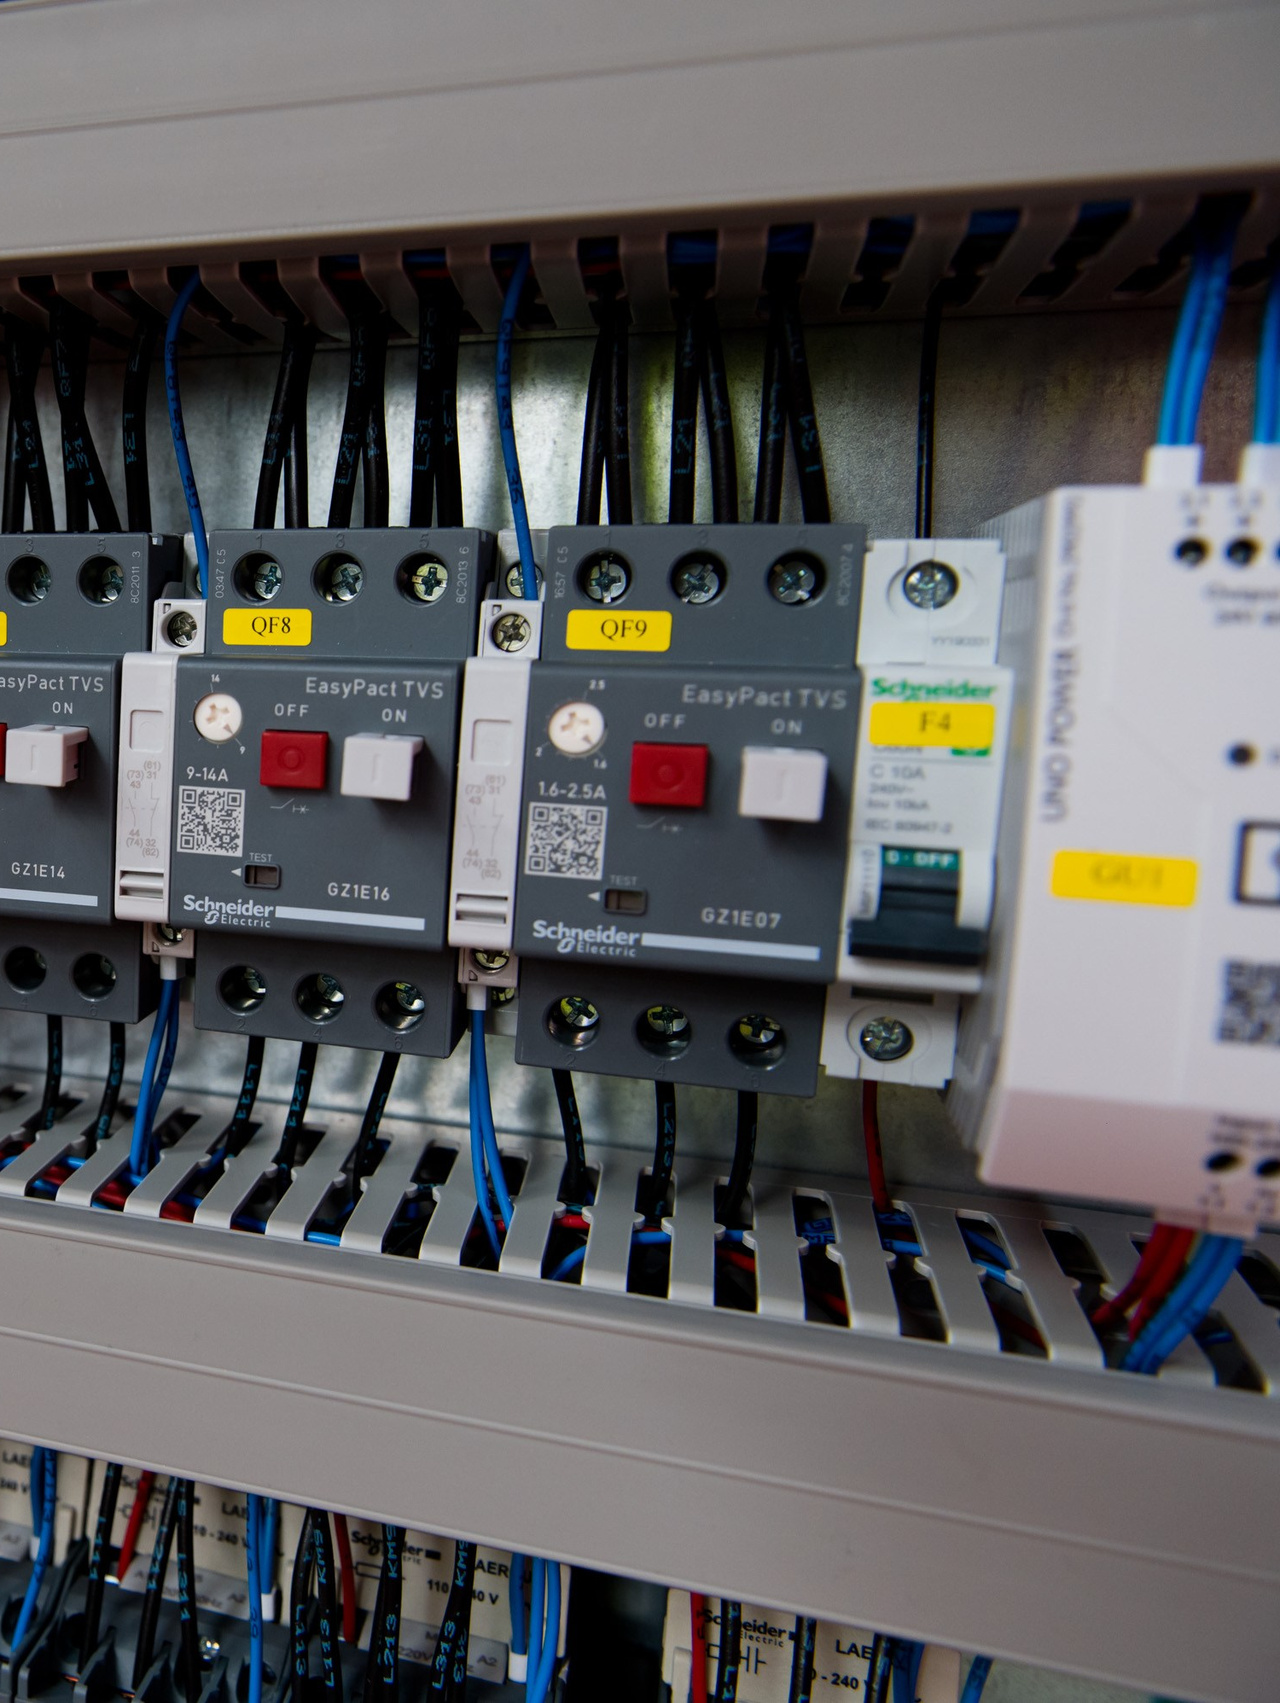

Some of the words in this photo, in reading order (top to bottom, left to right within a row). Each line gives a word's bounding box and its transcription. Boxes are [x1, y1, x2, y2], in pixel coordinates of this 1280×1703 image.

[251, 617, 291, 637] QF8
[599, 619, 647, 641] QF9
[69, 677, 104, 692] TVS
[306, 677, 397, 699] EasyPact
[403, 681, 444, 699] TVS
[871, 677, 998, 701] Schneider
[682, 684, 792, 711] EasyPact
[799, 689, 848, 710] TVS
[52, 702, 73, 714] ON
[274, 704, 309, 717] OFF
[382, 709, 407, 723] ON
[644, 712, 687, 730] OFF
[771, 718, 803, 736] ON
[919, 711, 951, 733] F4
[187, 766, 229, 783] 9-14A
[537, 781, 607, 801] 1.6-2.5A
[249, 853, 272, 862] TEST
[11, 862, 66, 879] GZ1E14
[609, 874, 638, 887] TEST
[327, 882, 390, 902] GZ1E16
[183, 894, 275, 919] Schneider
[221, 914, 271, 928] Electric
[700, 907, 782, 930] GZ1E07
[532, 919, 642, 947] Schneider
[576, 942, 638, 959] Electric
[477, 1654, 498, 1668] A2
[831, 1672, 860, 1690] 240
